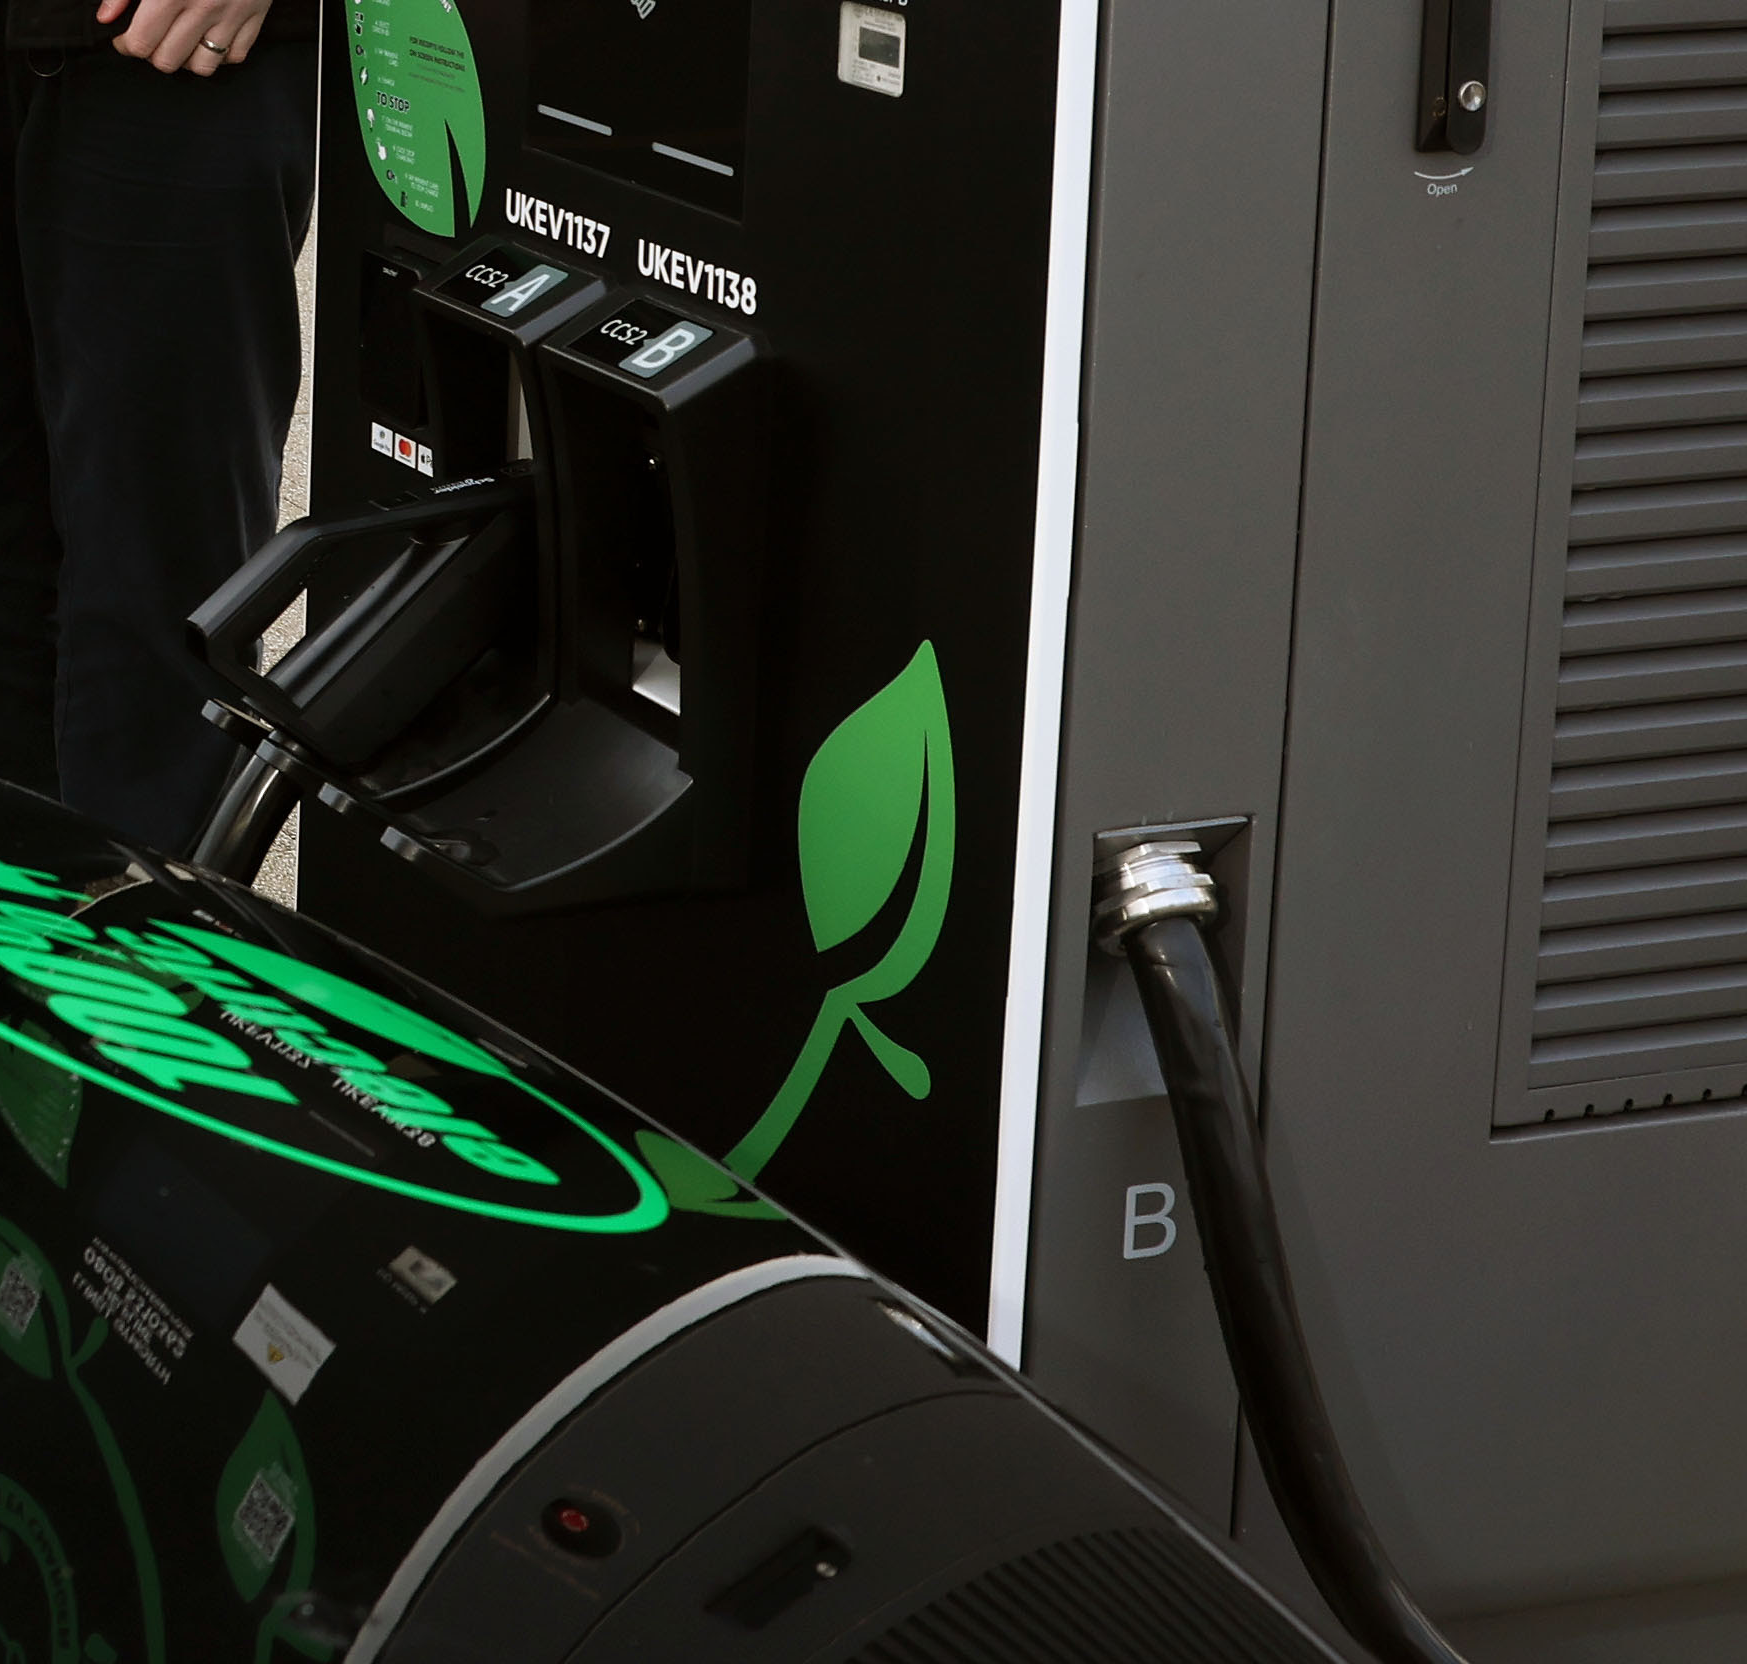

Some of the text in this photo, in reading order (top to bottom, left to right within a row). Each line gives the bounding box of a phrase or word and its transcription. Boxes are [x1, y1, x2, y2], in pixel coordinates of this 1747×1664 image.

[376, 90, 410, 113] TO STOP
[1427, 181, 1458, 197] Open
[506, 188, 610, 258] UKEV1137
[465, 264, 550, 313] CCS2 A
[637, 239, 757, 315] UKEV1138
[600, 317, 695, 370] CCS2 B
[1124, 1183, 1177, 1259] B
